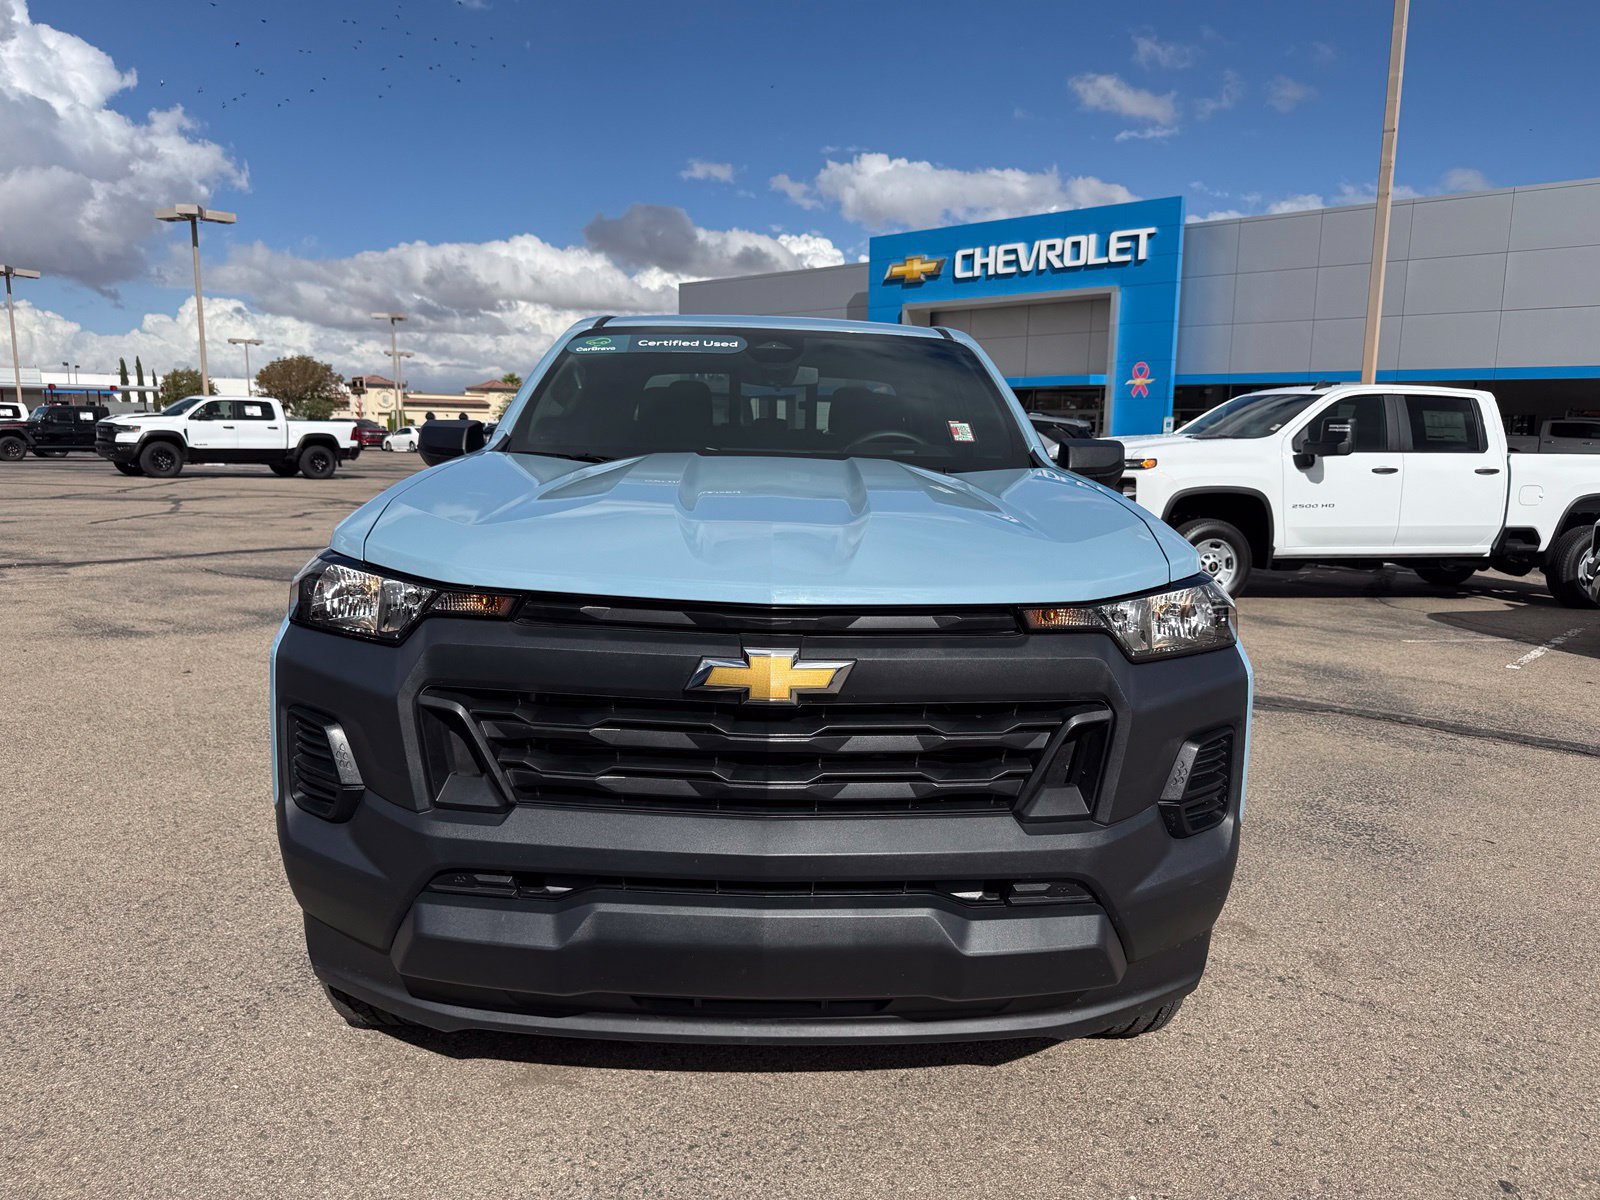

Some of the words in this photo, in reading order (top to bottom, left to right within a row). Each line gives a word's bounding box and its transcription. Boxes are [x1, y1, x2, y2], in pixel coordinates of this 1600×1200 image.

[954, 227, 1158, 279] CHEVROLET
[637, 339, 700, 348] Certified
[703, 340, 739, 348] Used
